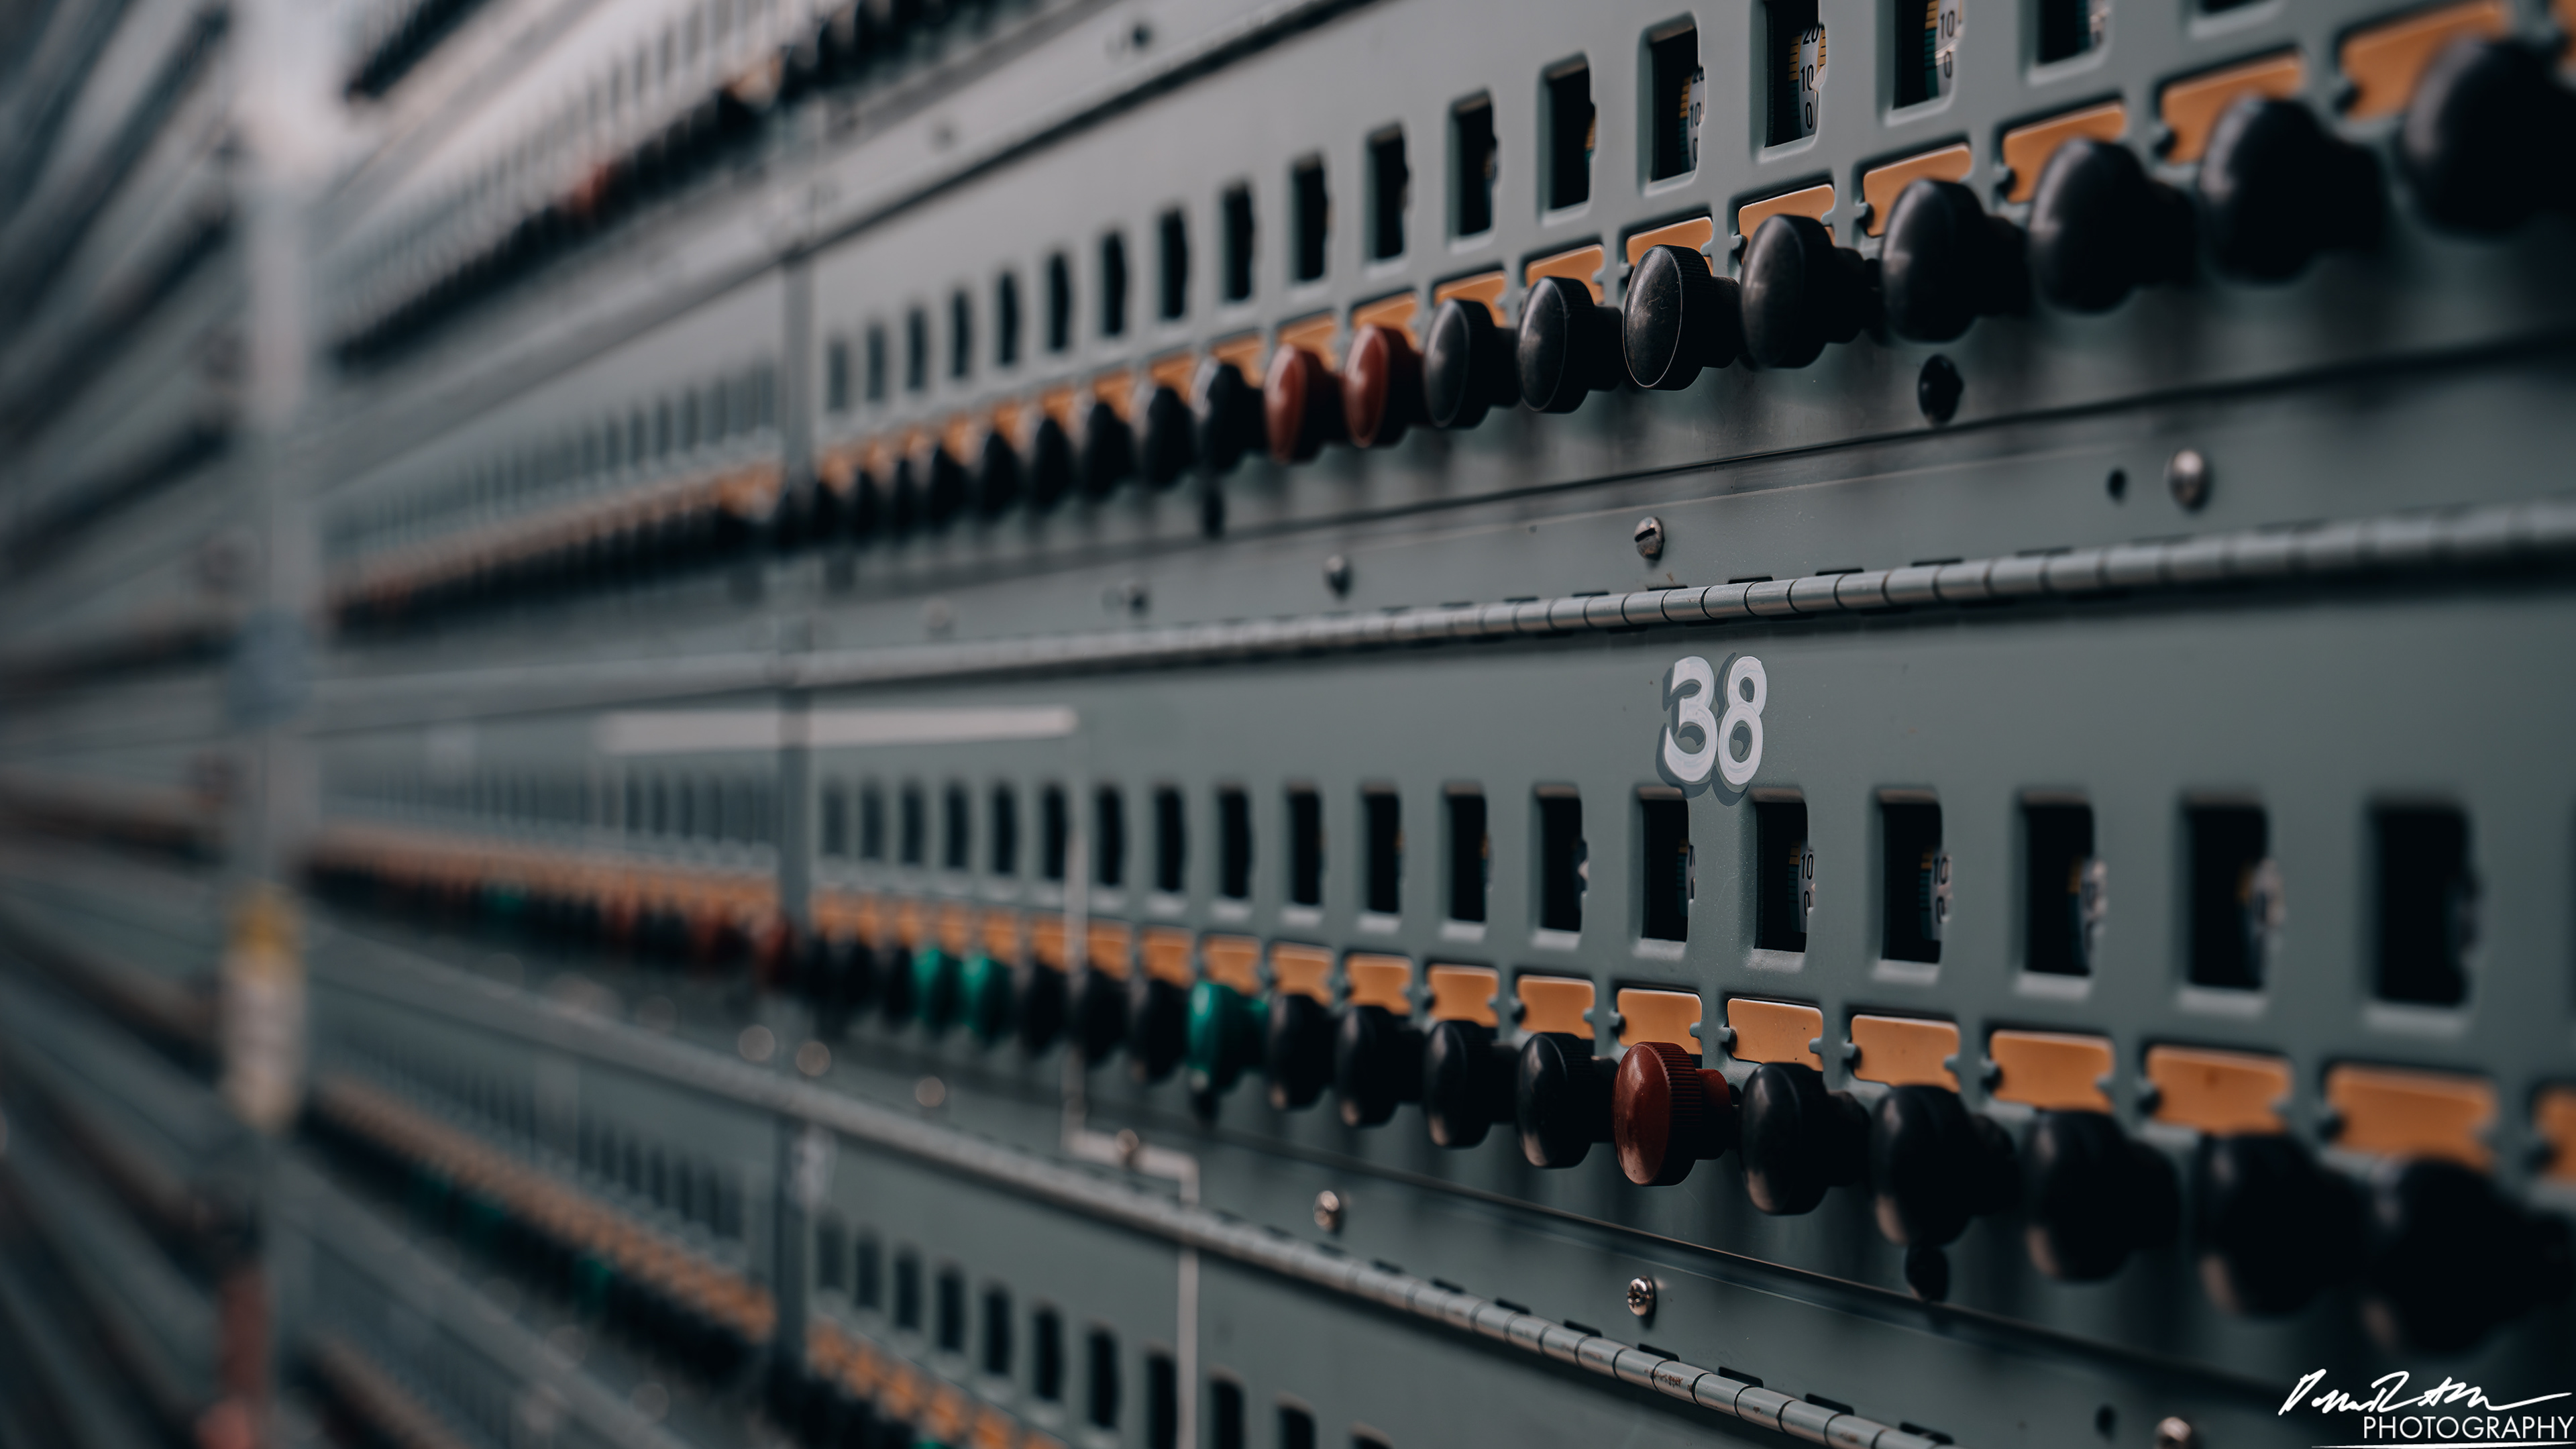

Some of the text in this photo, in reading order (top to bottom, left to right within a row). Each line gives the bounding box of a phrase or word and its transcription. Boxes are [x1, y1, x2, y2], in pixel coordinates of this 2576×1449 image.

[1940, 10, 1955, 40] 10
[1801, 64, 1814, 93] 10
[1690, 102, 1701, 128] 10
[1805, 101, 1813, 129] 0
[1664, 655, 1767, 786] 38
[1801, 853, 1813, 879] 10
